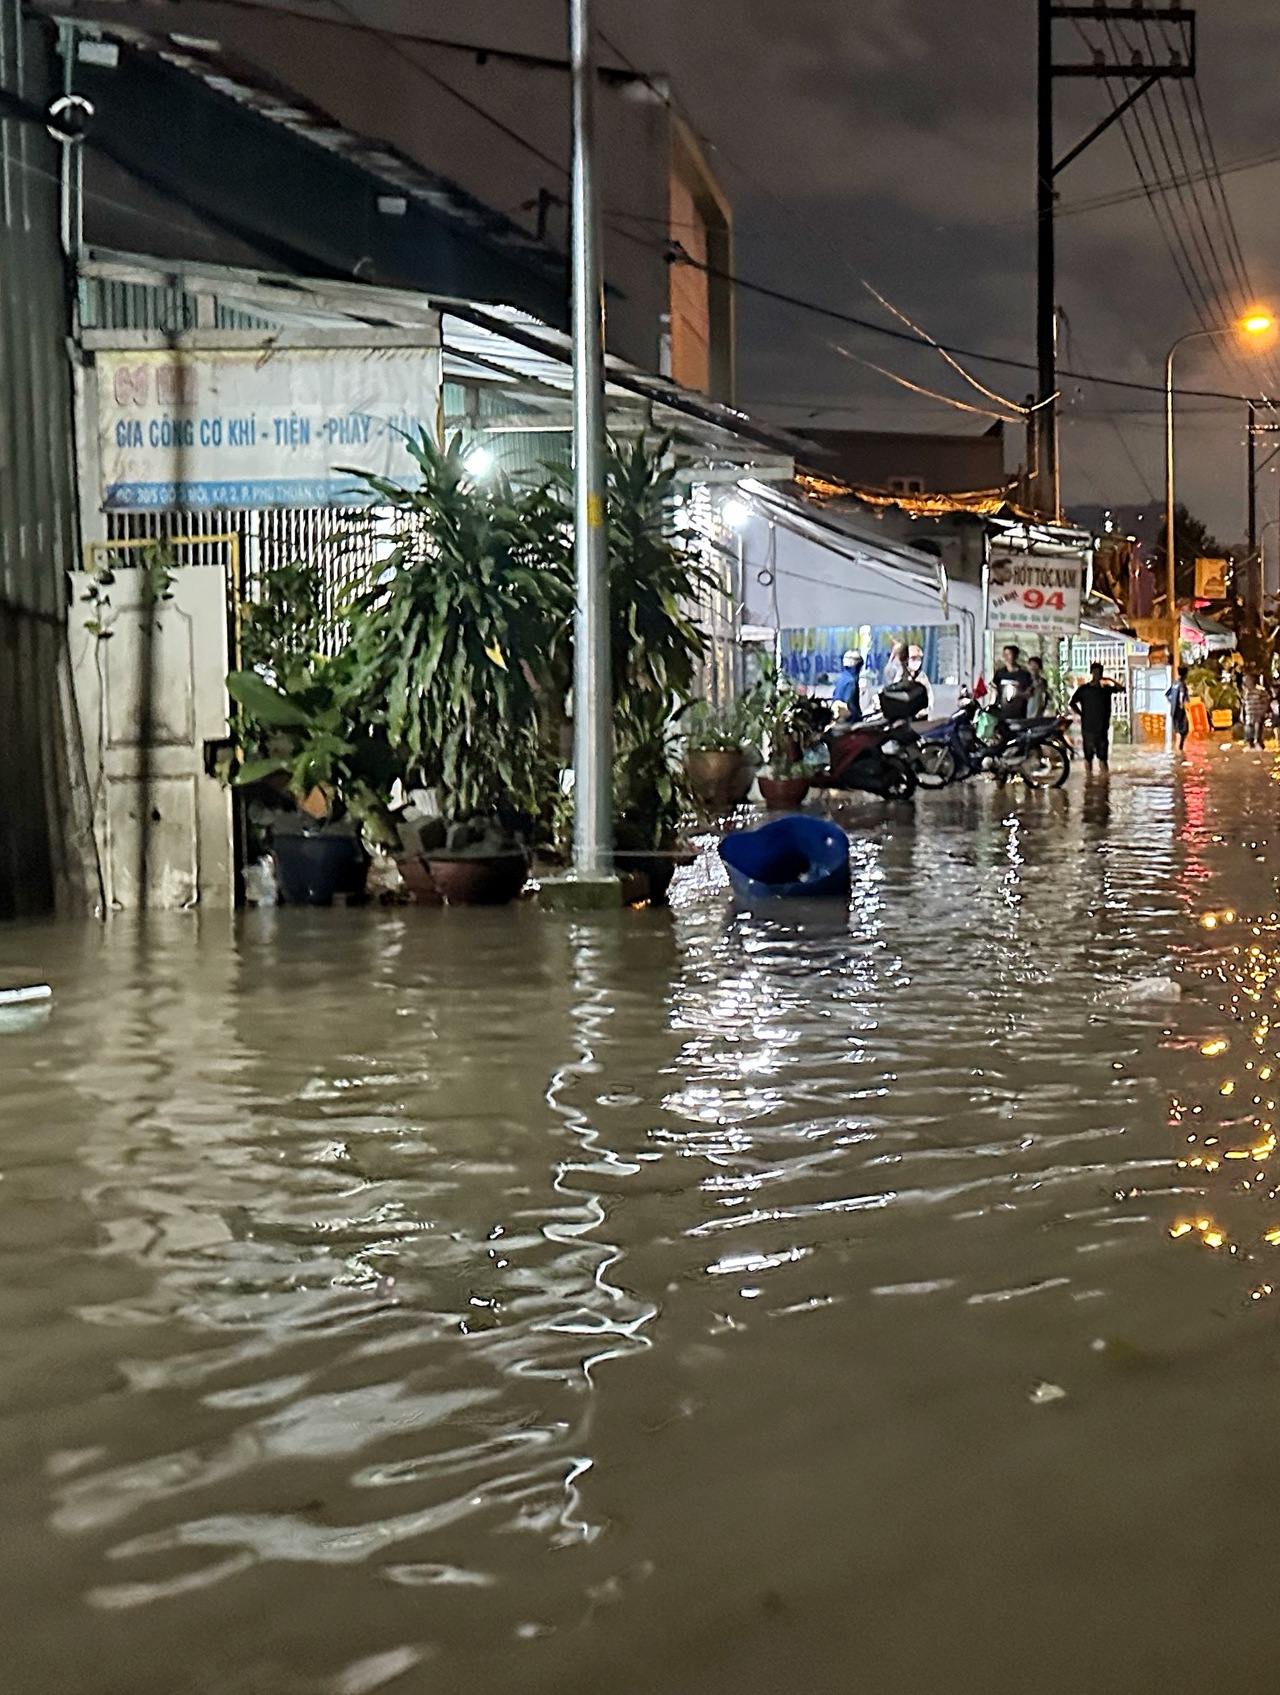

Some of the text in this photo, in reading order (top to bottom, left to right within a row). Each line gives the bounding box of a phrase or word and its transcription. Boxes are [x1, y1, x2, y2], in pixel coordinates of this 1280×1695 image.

[115, 418, 143, 448] GIA
[149, 413, 194, 448] CÔNG
[200, 416, 223, 447] CƠ
[228, 411, 256, 447] KHÍ
[273, 411, 311, 451] TIỆN
[328, 417, 370, 444] PHAY
[1023, 588, 1066, 611] 94
